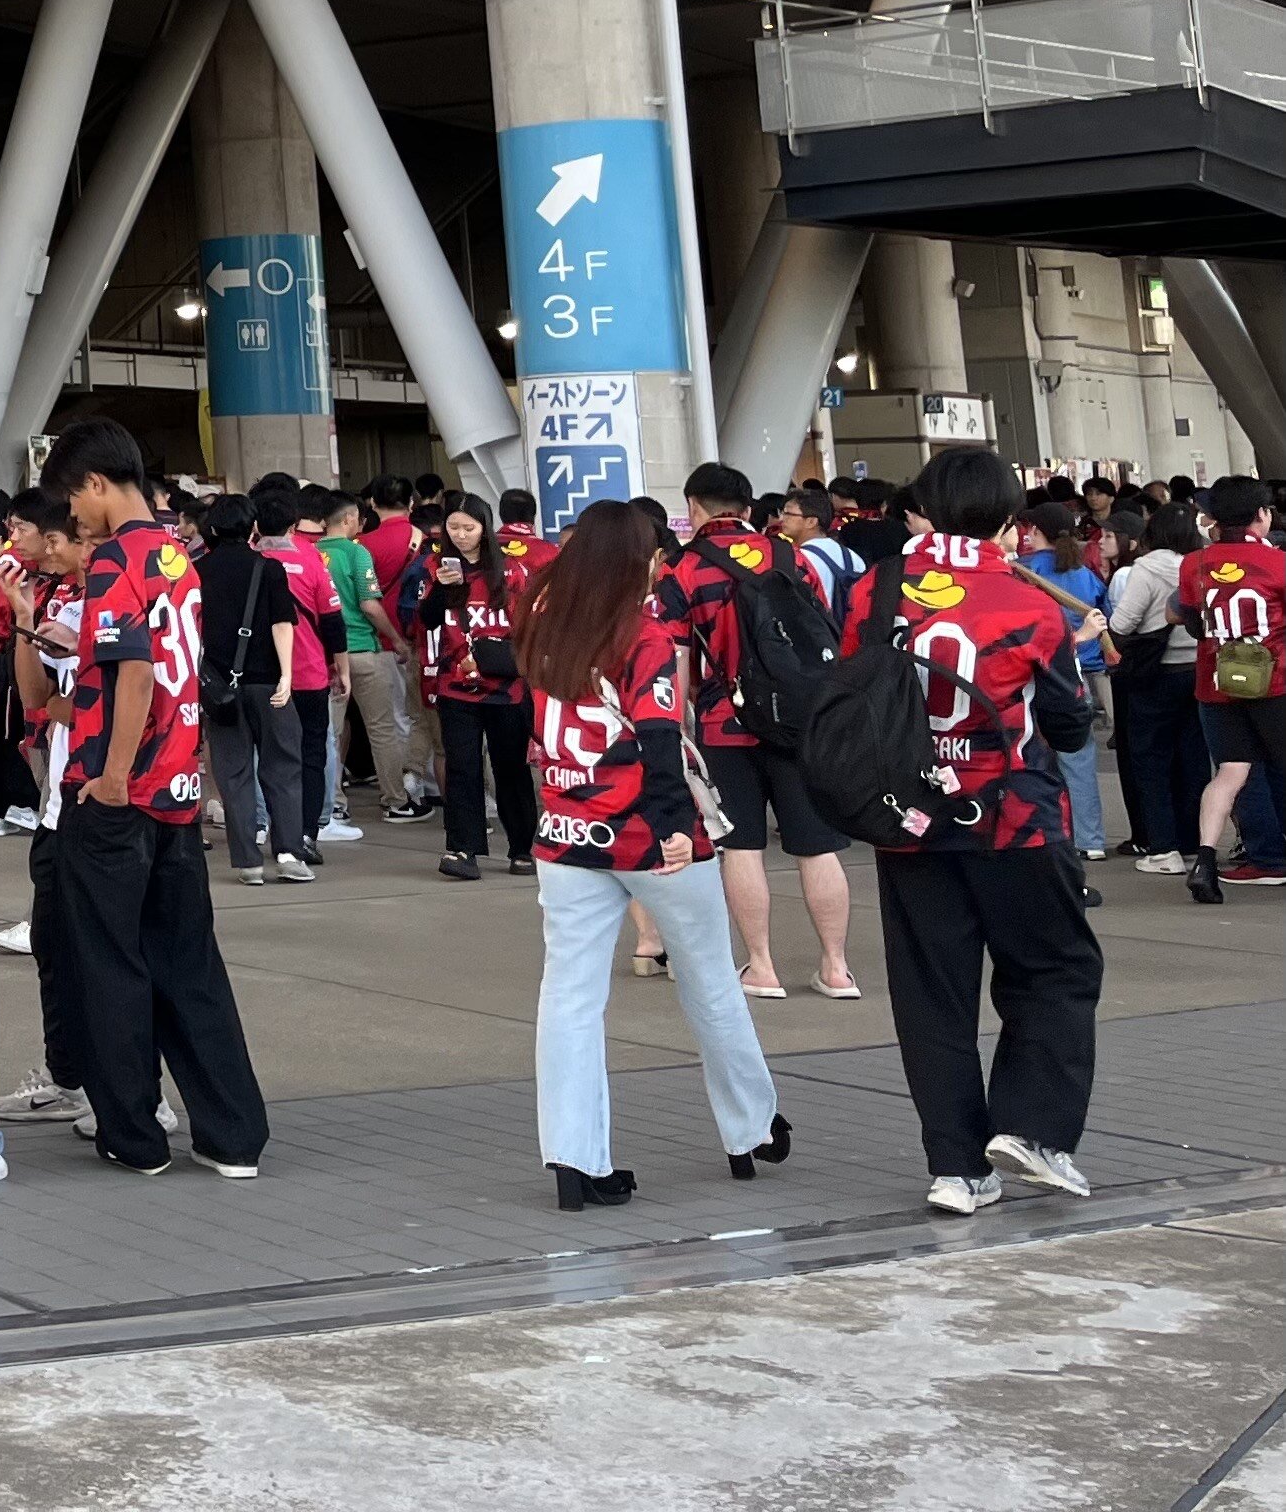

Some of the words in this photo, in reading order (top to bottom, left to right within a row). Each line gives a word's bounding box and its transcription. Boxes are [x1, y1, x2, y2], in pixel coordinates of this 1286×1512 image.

[538, 238, 609, 282] 4F
[542, 294, 614, 339] 3F
[528, 379, 627, 409] イーストゾーン
[823, 389, 841, 407] 21
[926, 397, 942, 412] 20
[540, 414, 578, 441] 4F
[445, 607, 511, 628] LXIL
